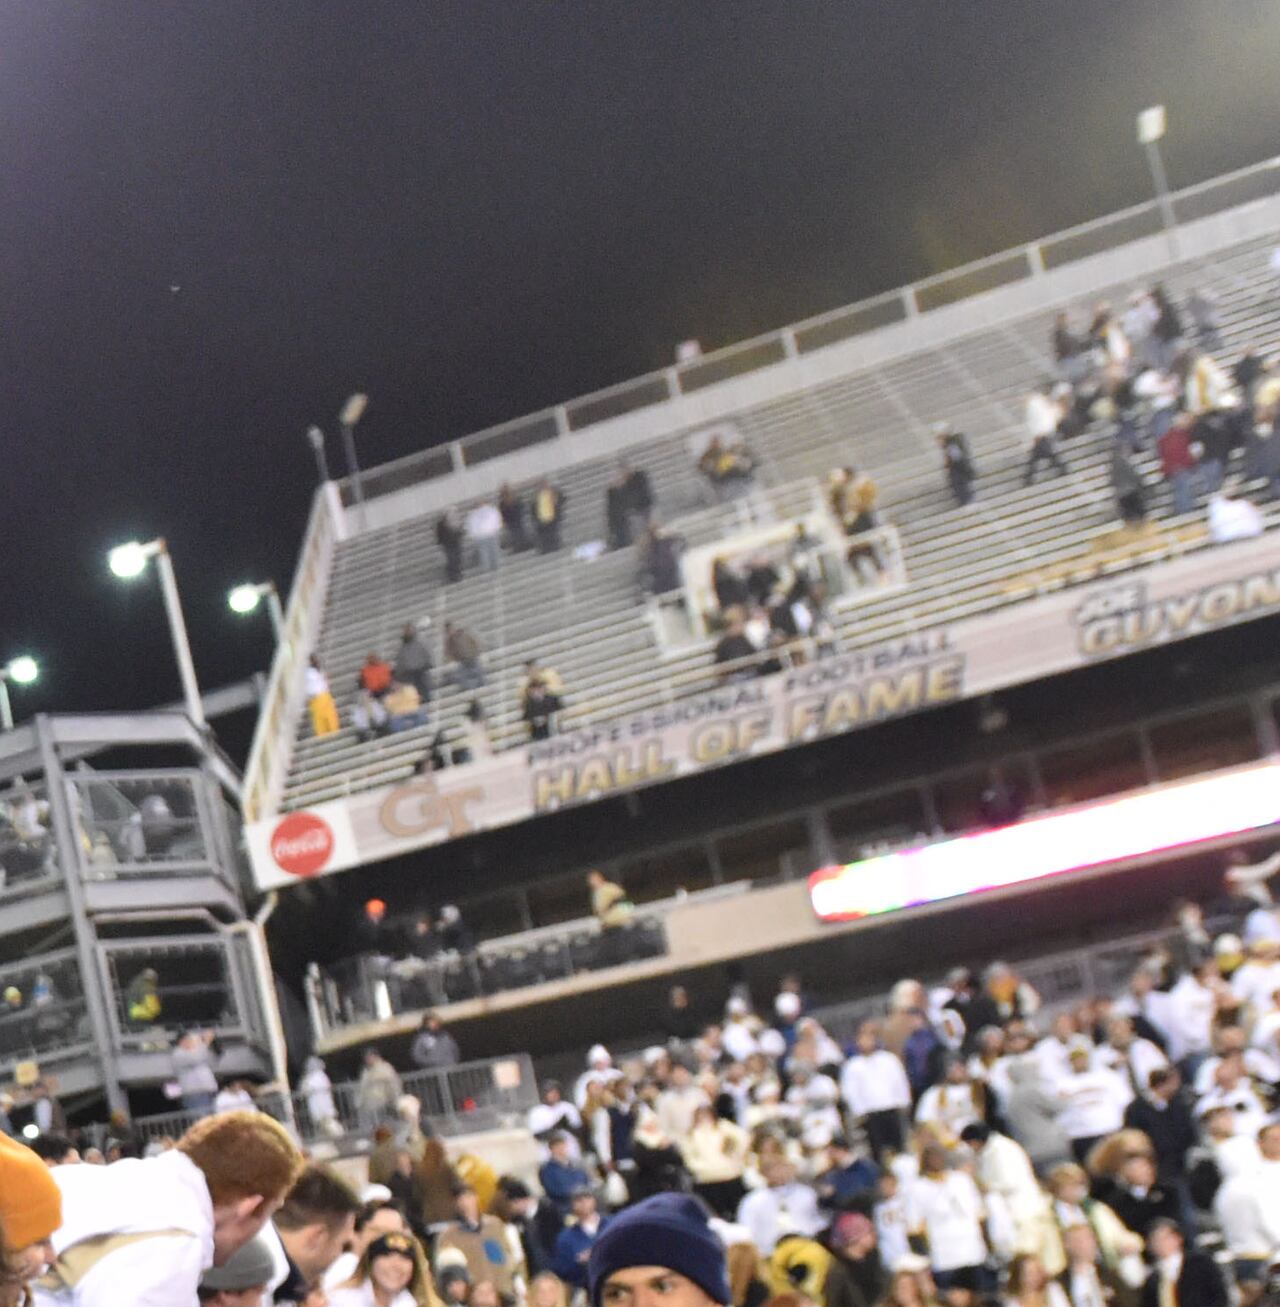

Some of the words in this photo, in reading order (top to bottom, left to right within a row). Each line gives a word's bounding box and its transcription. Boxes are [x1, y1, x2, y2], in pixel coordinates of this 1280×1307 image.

[527, 684, 766, 765] PROFESSIONAL
[785, 633, 953, 692] FOOTBALL
[533, 740, 676, 806] HALL
[690, 710, 772, 765] OF
[784, 654, 966, 740] FAME
[378, 781, 486, 838] GT
